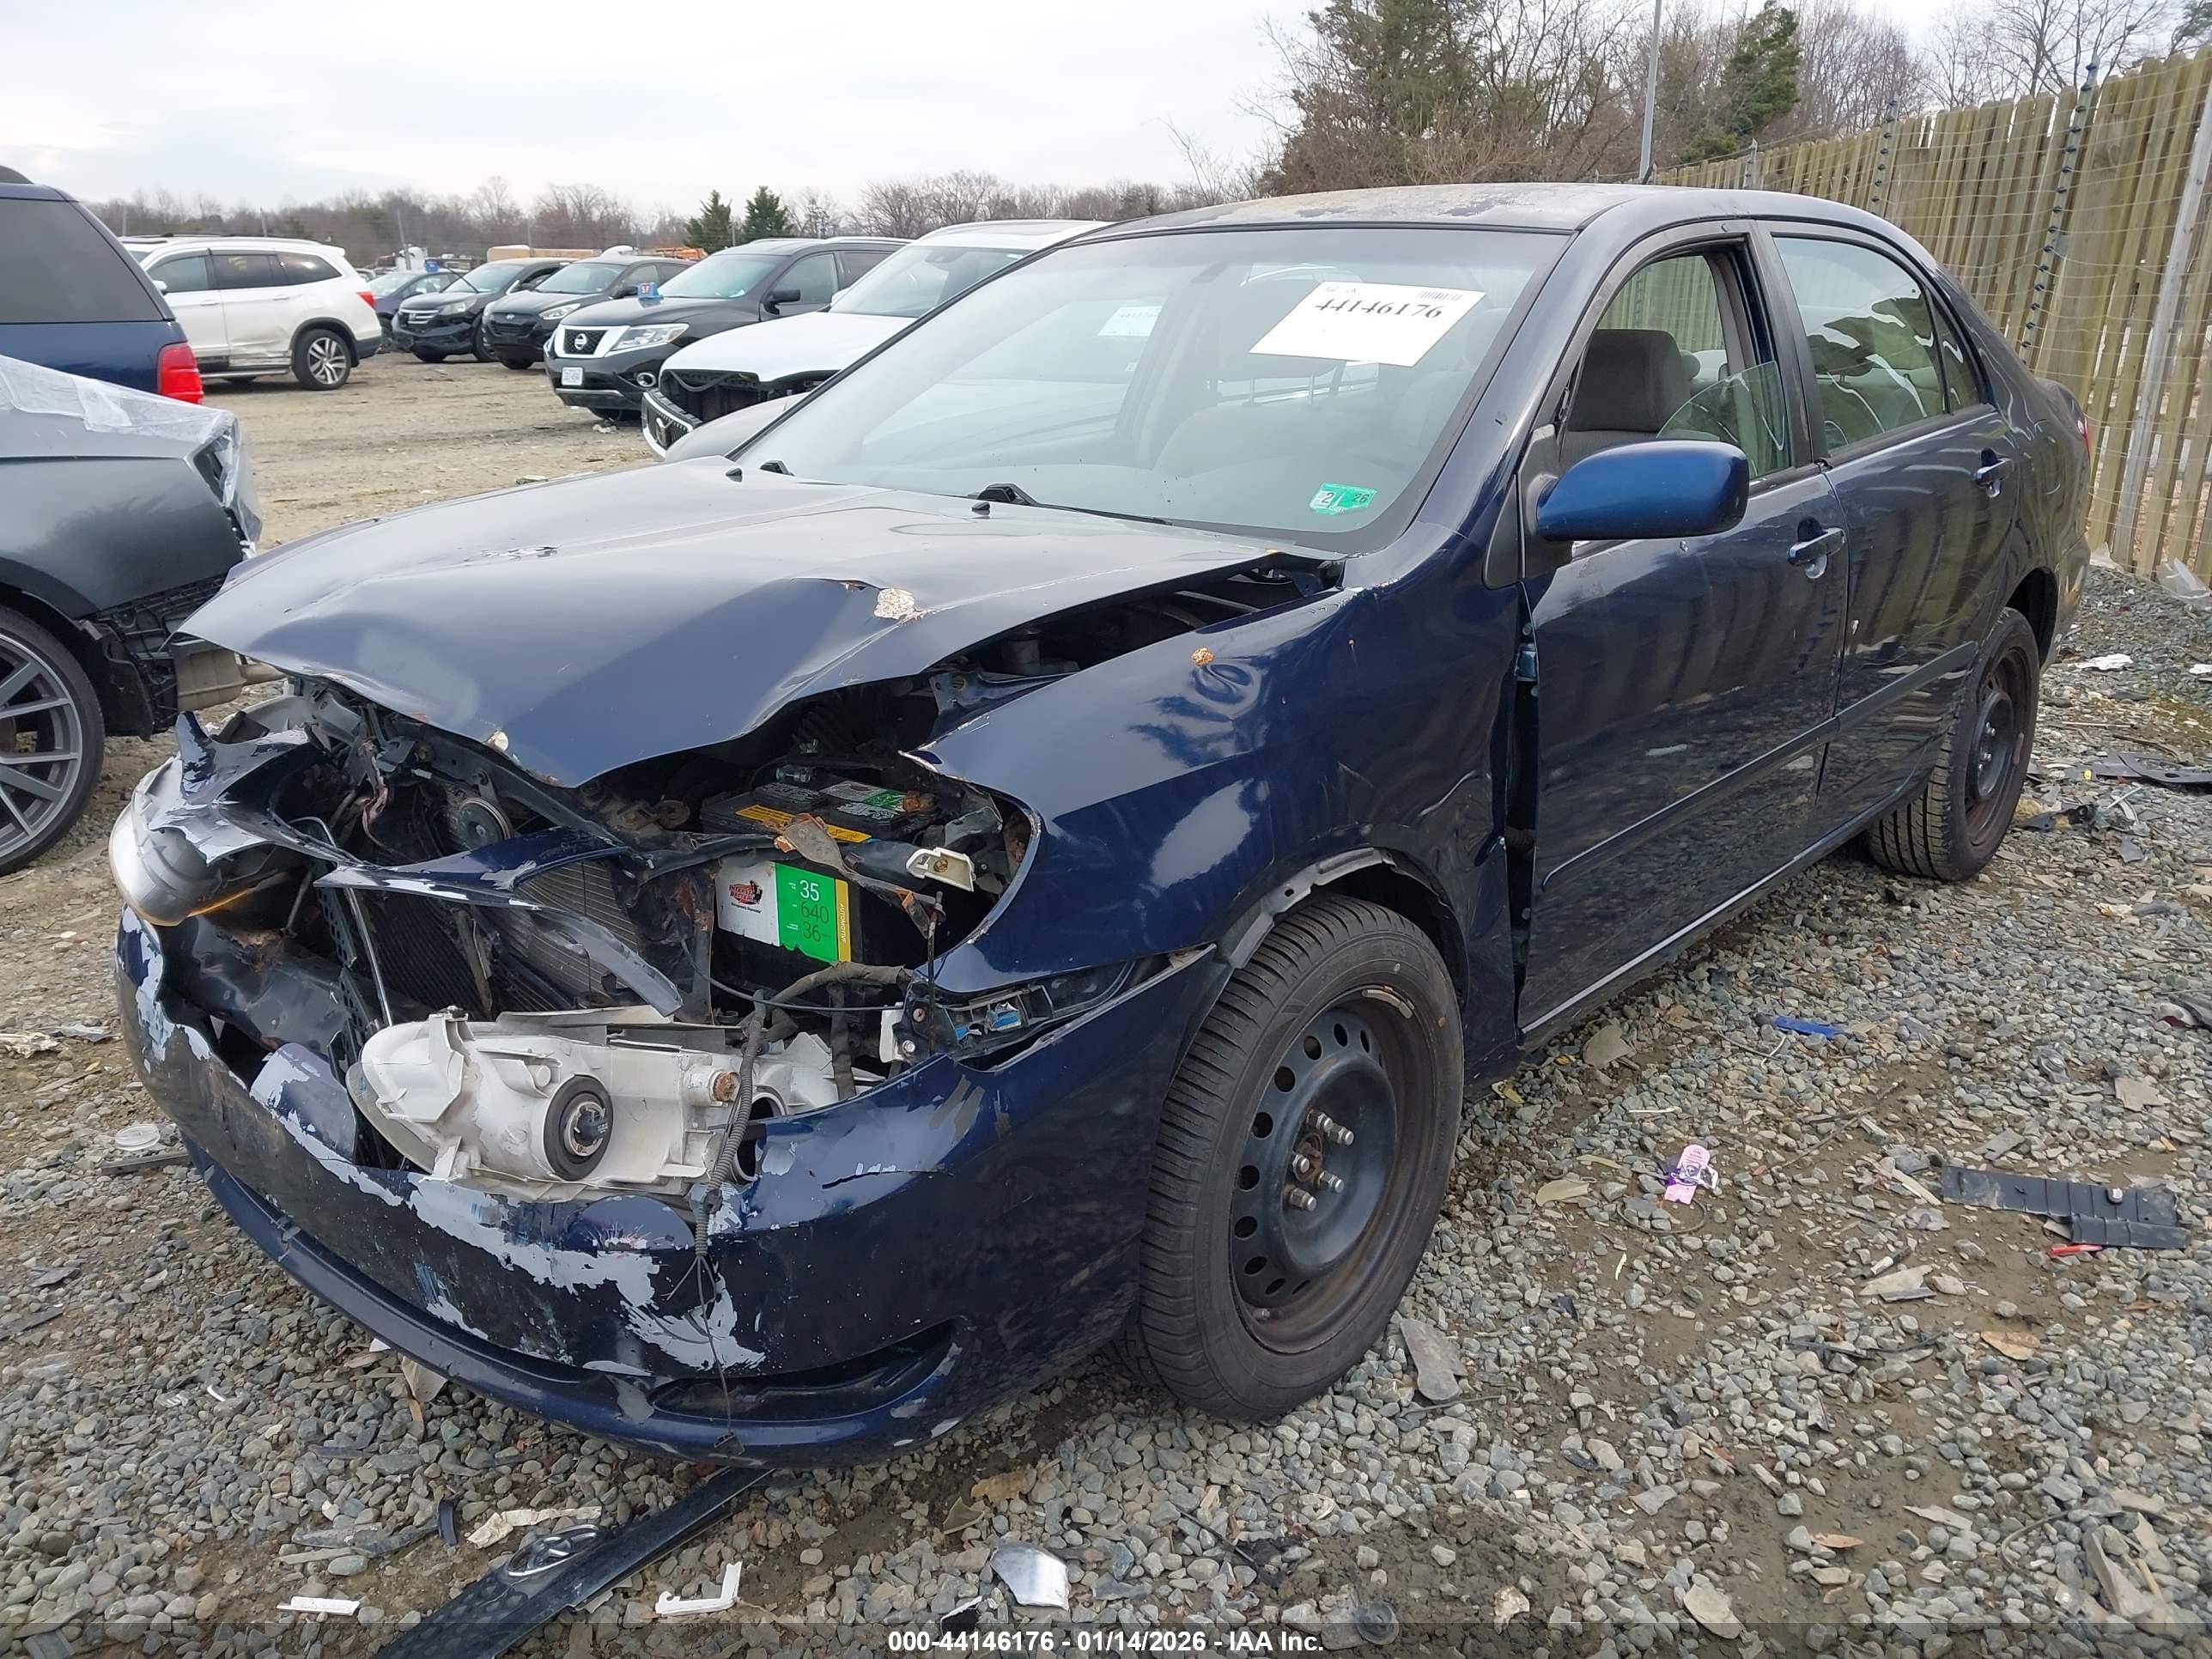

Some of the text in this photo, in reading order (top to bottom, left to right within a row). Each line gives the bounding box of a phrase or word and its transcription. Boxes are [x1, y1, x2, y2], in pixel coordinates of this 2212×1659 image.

[1315, 298, 1445, 319] 44146176
[1322, 492, 1370, 504] 2 26
[799, 879, 819, 902] 35
[801, 901, 830, 924] 640
[802, 921, 822, 942] 36
